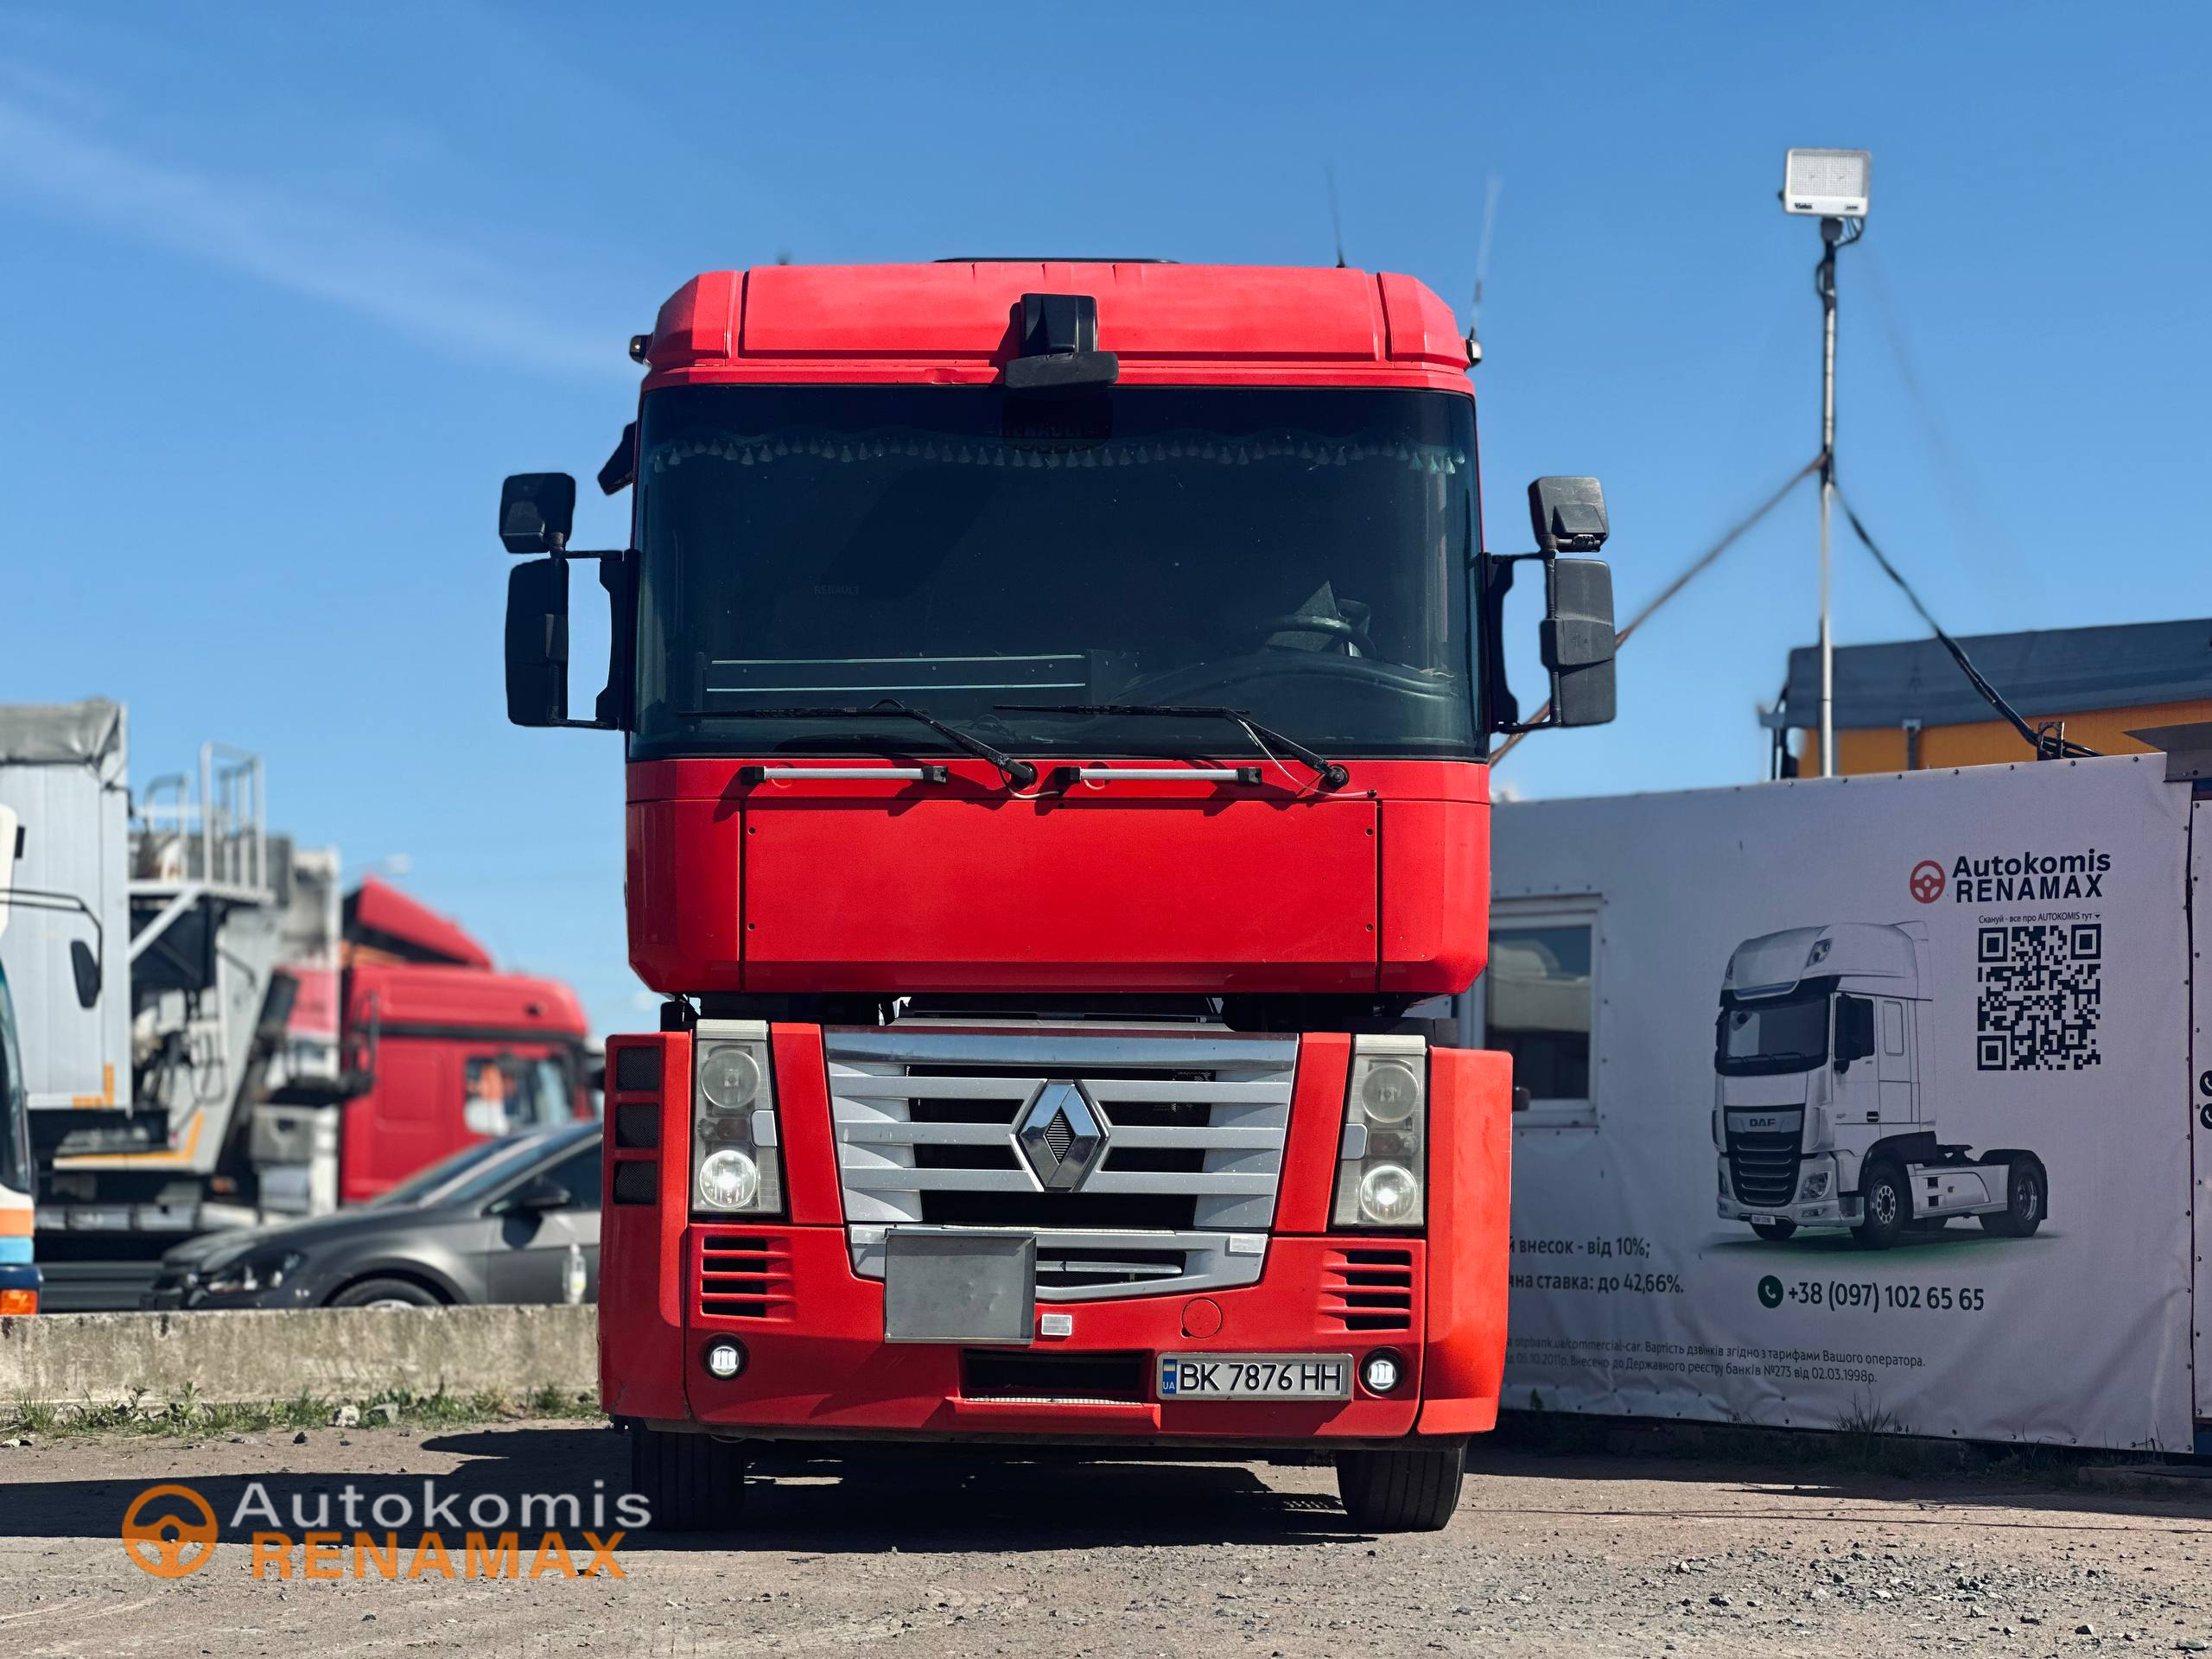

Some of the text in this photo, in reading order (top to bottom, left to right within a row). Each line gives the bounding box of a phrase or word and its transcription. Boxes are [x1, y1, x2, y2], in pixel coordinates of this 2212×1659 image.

[1952, 849, 2111, 878] Autokomis
[1956, 874, 2103, 903] RENAMAX
[1979, 914, 2004, 925] Скануй
[2023, 915, 2037, 924] про
[2037, 912, 2080, 922] AUTOKOMIS
[1749, 1118, 1777, 1128] DAF
[1519, 1239, 1574, 1255] внесок
[1586, 1236, 1613, 1259] від
[1616, 1236, 1651, 1259] 10%;
[1535, 1274, 1594, 1290] ставка:
[1597, 1276, 1620, 1294] до
[1623, 1273, 1685, 1295] 42,66%.
[1789, 1281, 1985, 1313] +38 (097) 102 65 65
[1570, 1354, 1610, 1369] Внесено
[1611, 1359, 1624, 1370] до
[1625, 1357, 1685, 1372] Державного
[1688, 1363, 1723, 1377] реєстру
[1726, 1363, 1761, 1376] банків
[1764, 1365, 1792, 1378] №273
[1794, 1367, 1810, 1381] від
[1811, 1367, 1878, 1384] 02.03.1998р.
[1645, 1341, 1685, 1356] Вартість
[1686, 1344, 1724, 1357] дзвінків
[1726, 1345, 1759, 1360] згідно
[1761, 1350, 1767, 1359] з
[1768, 1348, 1820, 1363] тарифами
[1822, 1350, 1863, 1363] Вашого
[1865, 1354, 1926, 1370] оператора.
[1179, 1363, 1342, 1391] BK 7876 HH
